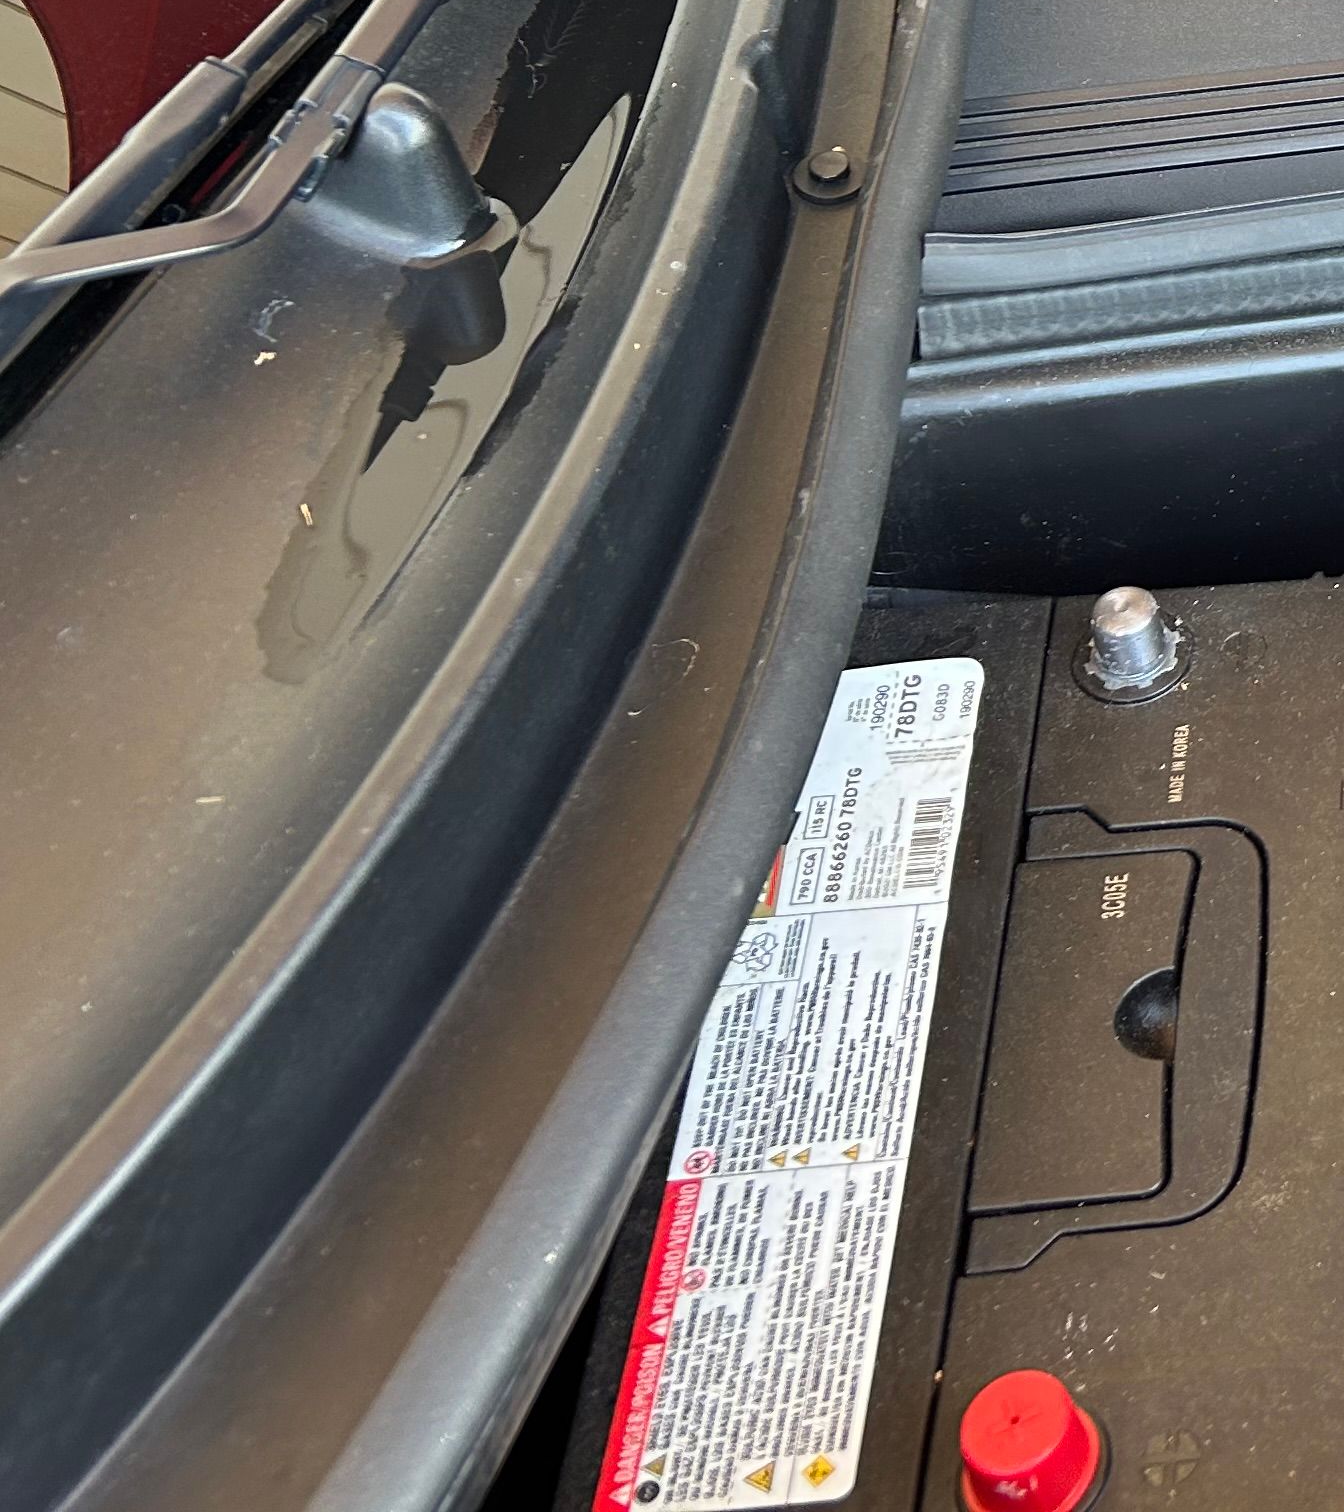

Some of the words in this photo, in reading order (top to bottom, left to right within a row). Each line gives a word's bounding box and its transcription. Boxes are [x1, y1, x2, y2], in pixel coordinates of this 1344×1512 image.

[870, 684, 891, 731] 190290
[894, 674, 922, 739] 78DTG
[959, 680, 976, 719] 190290
[1172, 724, 1190, 759] KOREA
[1171, 760, 1186, 772] IN
[1167, 773, 1185, 803] MADE
[810, 814, 823, 833] 115
[814, 800, 828, 814] RC
[823, 822, 853, 903] 88866260
[839, 767, 862, 818] 78DTG
[802, 853, 818, 877] CCA
[798, 879, 811, 900] 790
[1101, 872, 1129, 920] 3C05E
[614, 1343, 665, 1483] DANGER/POISON
[651, 1182, 700, 1316] PELIGRO/VENENO
